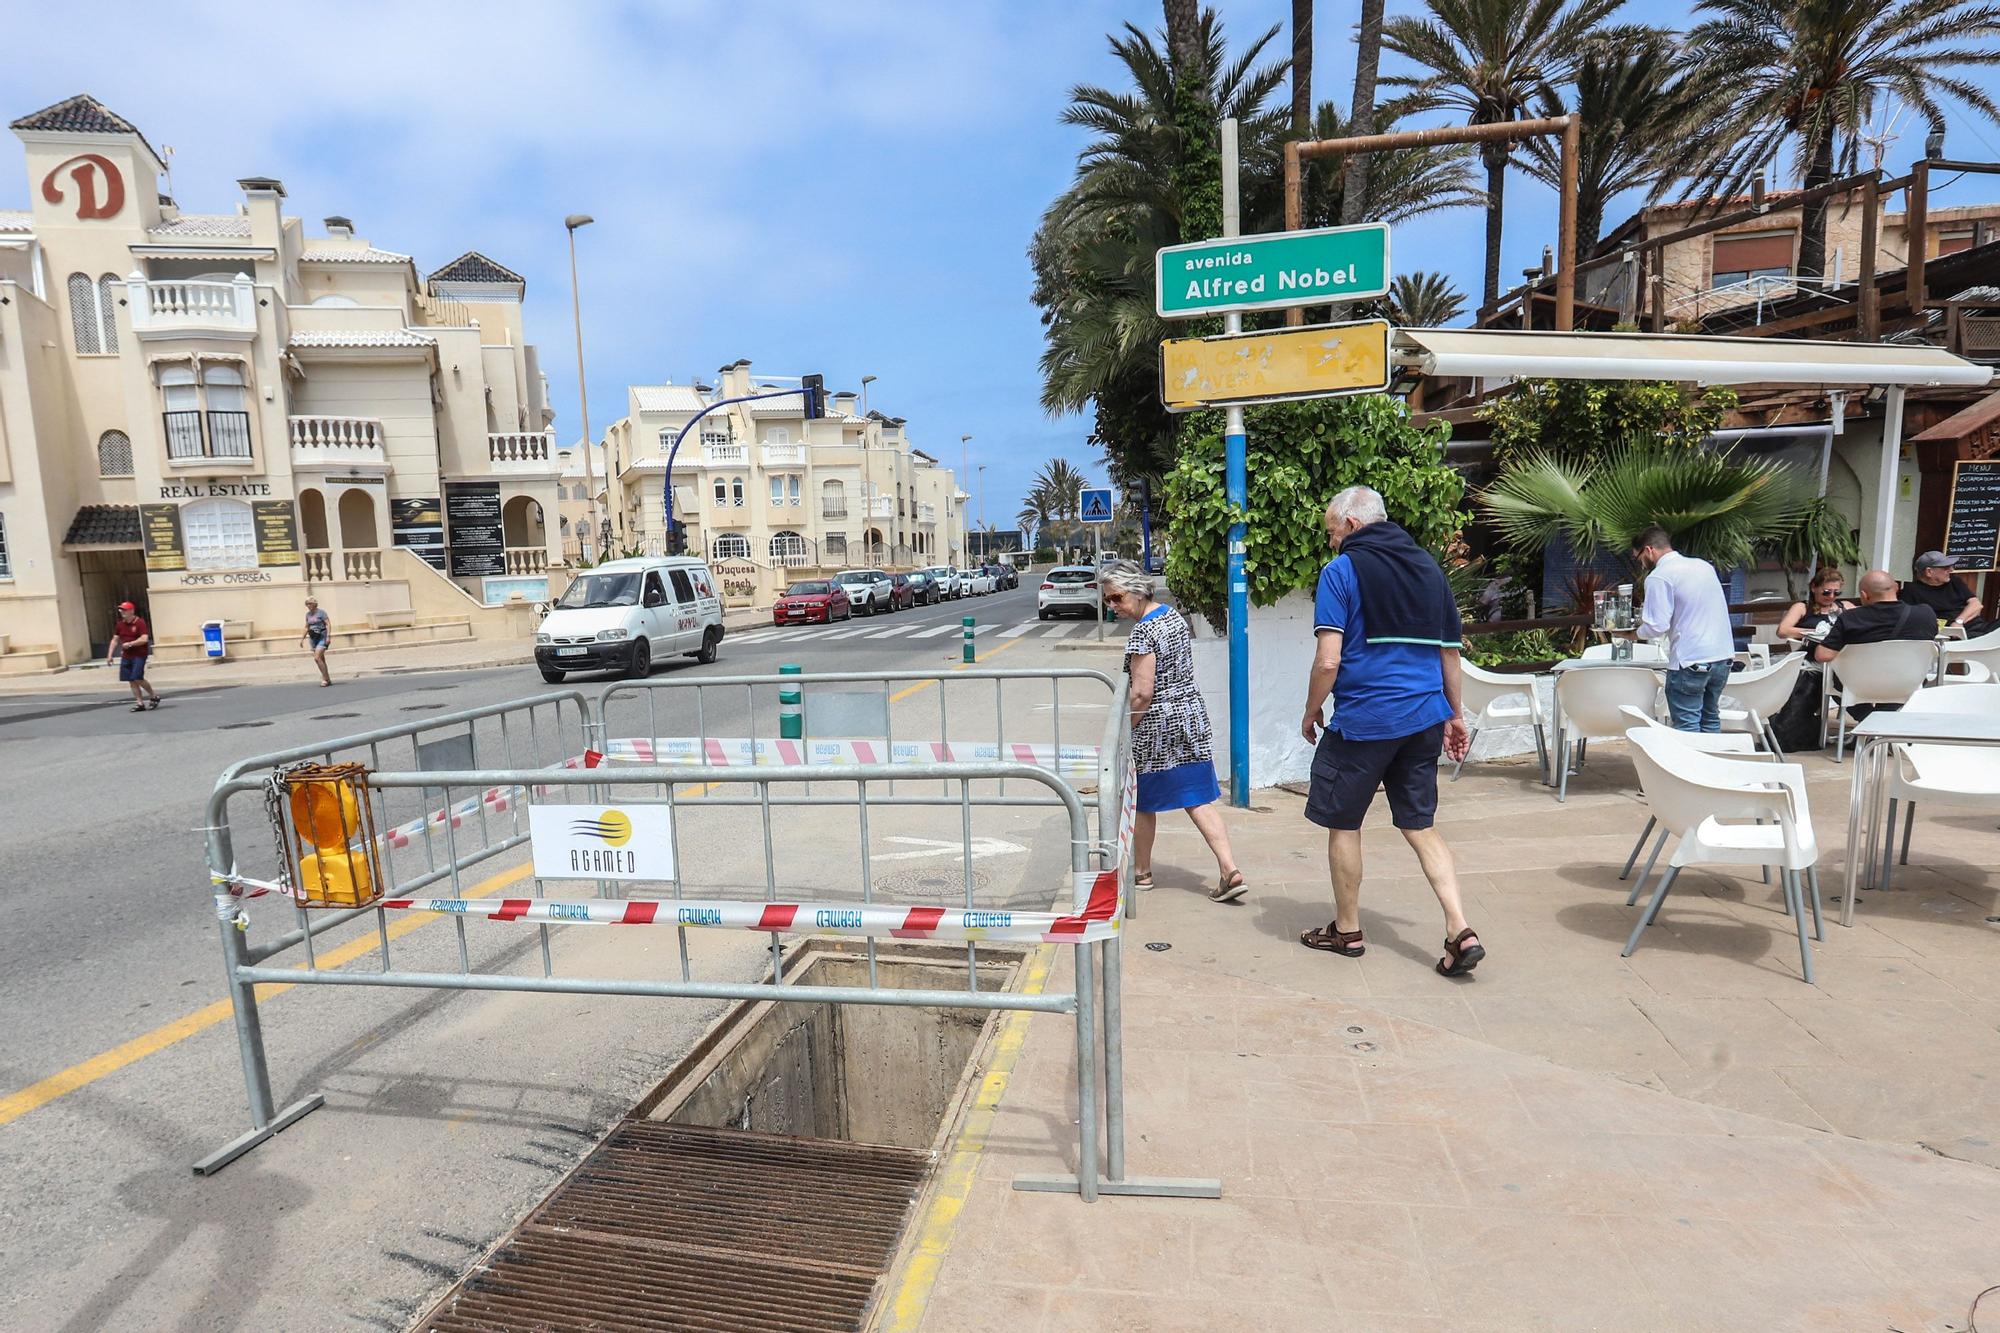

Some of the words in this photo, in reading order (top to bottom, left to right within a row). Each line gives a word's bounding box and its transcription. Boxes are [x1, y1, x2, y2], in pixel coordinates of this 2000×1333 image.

[41, 153, 125, 219] D
[1185, 252, 1253, 271] avenida
[1185, 274, 1266, 300] Alfred
[1279, 264, 1357, 290] Nobel
[160, 486, 204, 499] REAL
[208, 484, 271, 497] ESTATE
[180, 575, 215, 585] HOMES
[223, 573, 271, 584] OVERSEAS
[716, 565, 756, 576] Duquesa
[723, 578, 751, 589] Beach
[570, 849, 635, 873] AGAMED
[816, 910, 862, 928] AGAMED
[962, 912, 1012, 929] AGAMED
